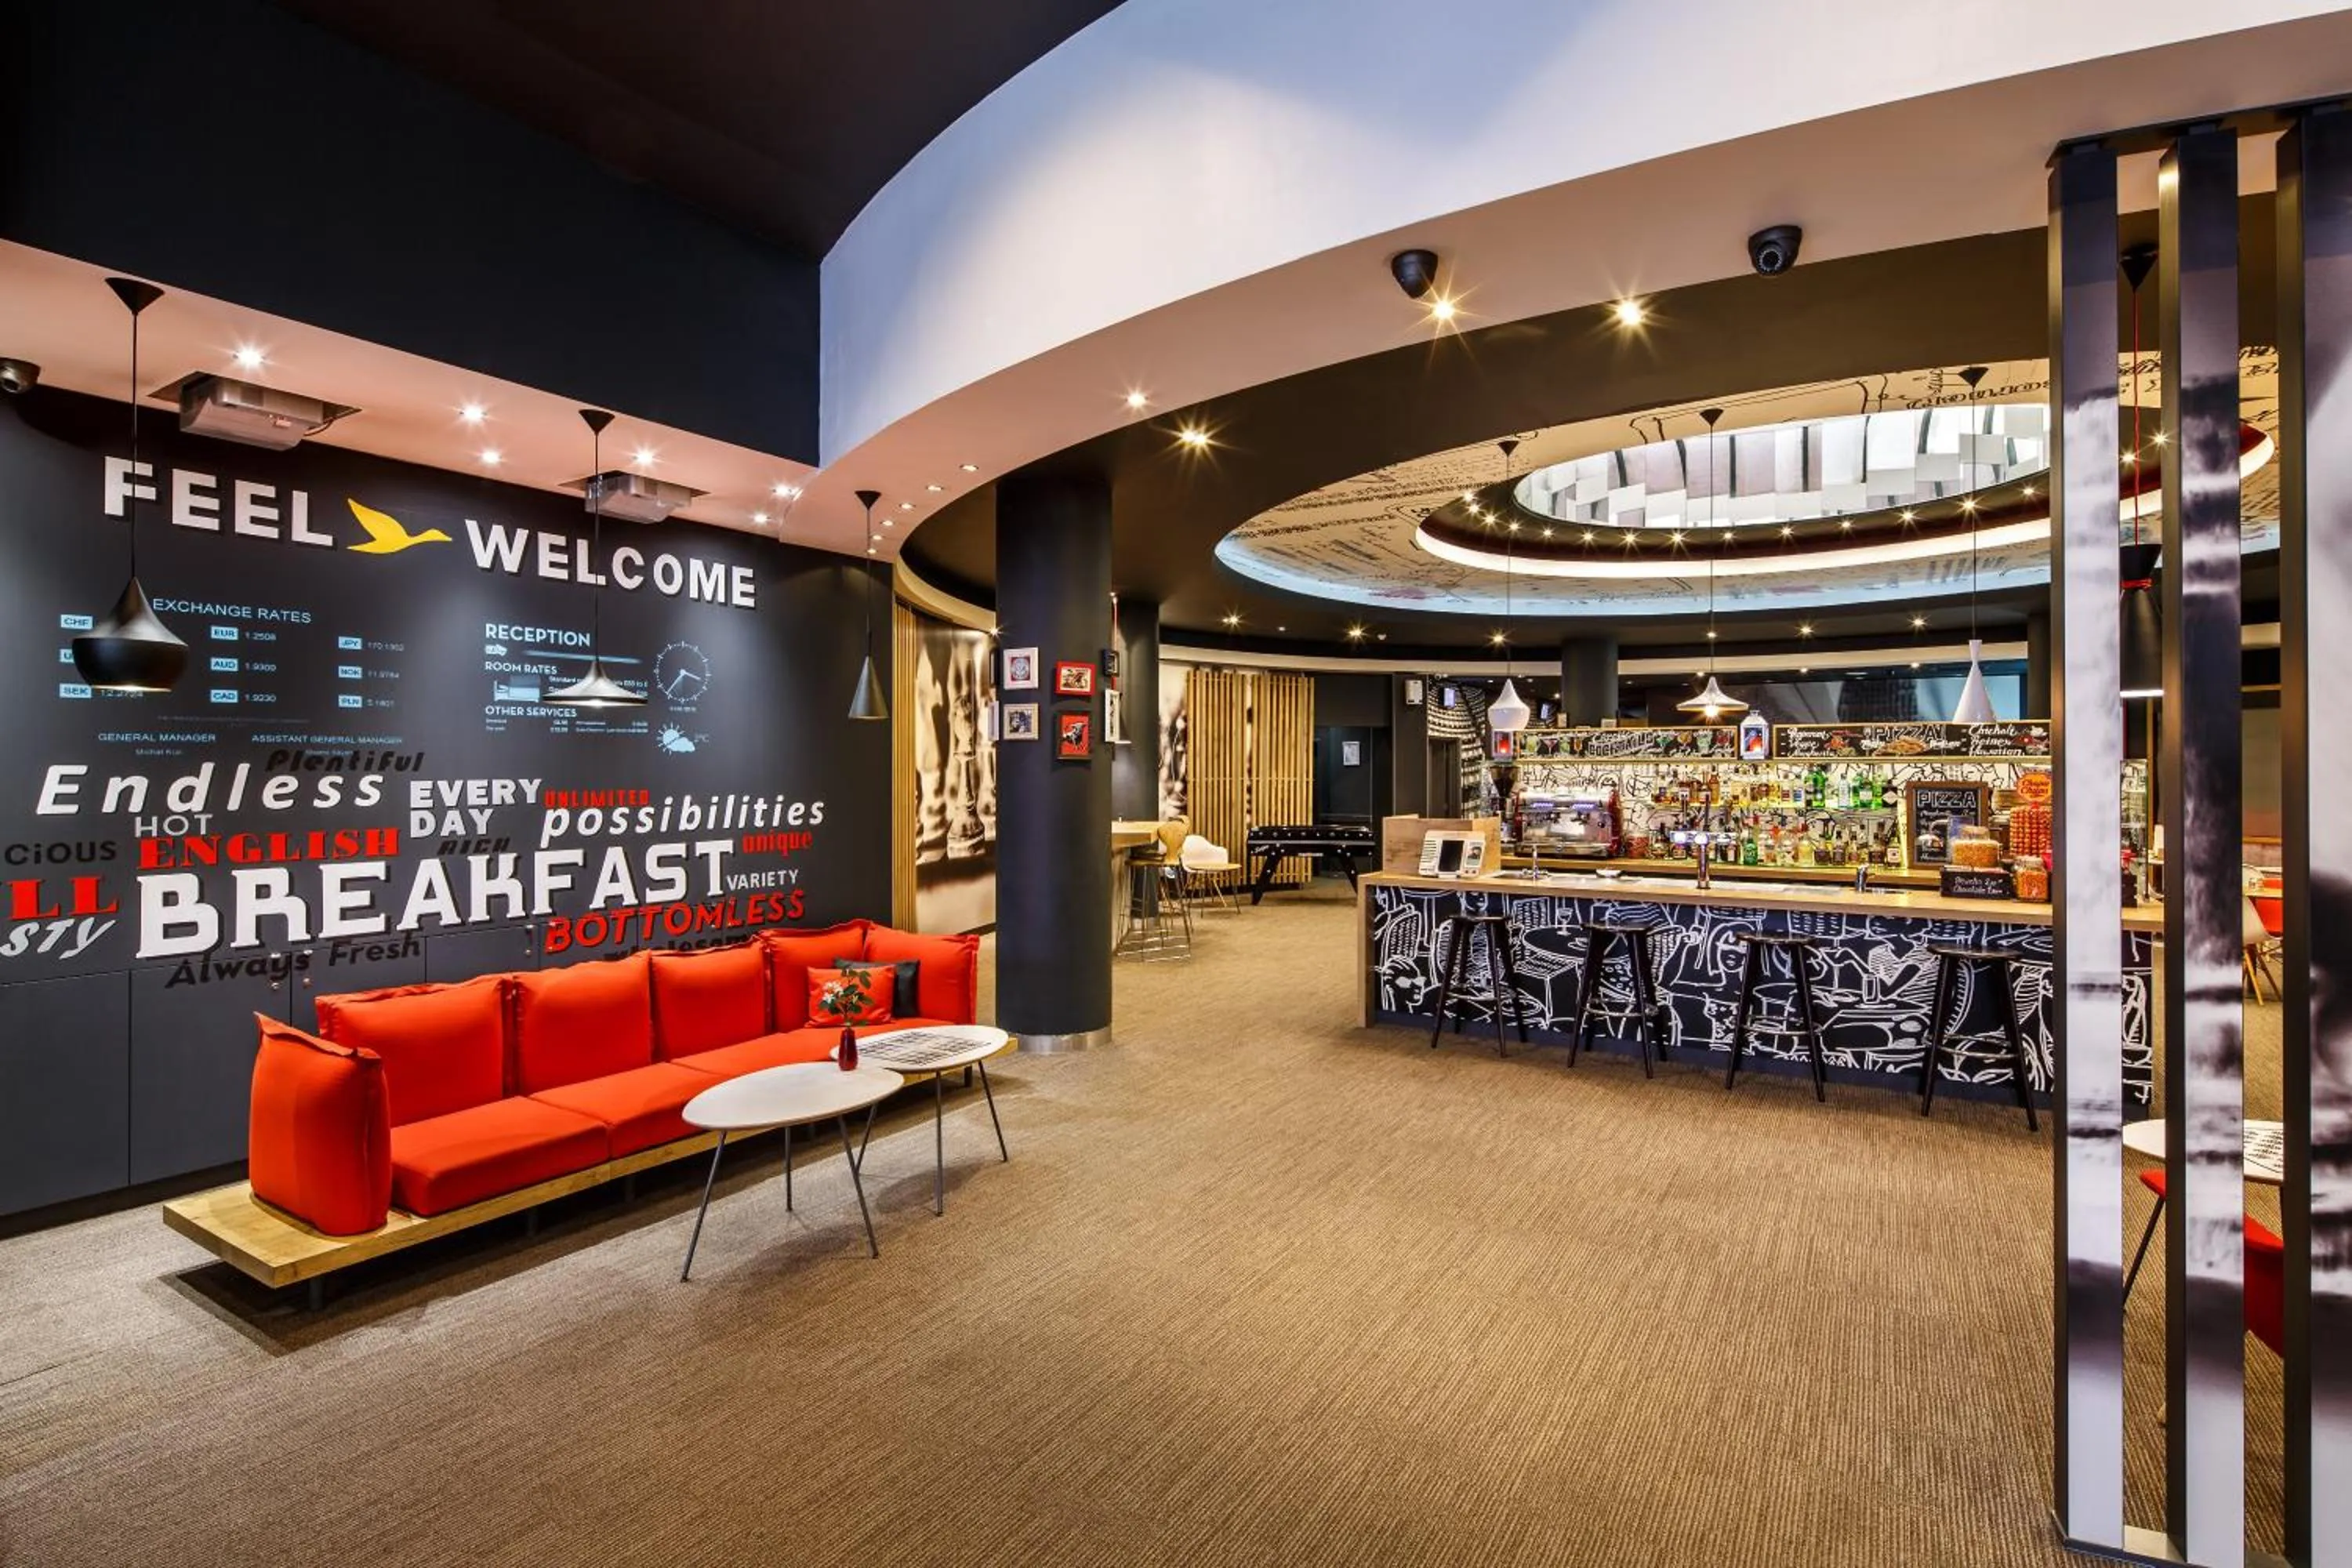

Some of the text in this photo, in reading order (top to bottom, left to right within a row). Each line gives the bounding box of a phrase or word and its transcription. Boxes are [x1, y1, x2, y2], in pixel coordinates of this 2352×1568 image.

[104, 456, 757, 609] FEEL WELCOME
[64, 617, 89, 626] CHF
[152, 598, 311, 623] EXCHANGE RATES
[213, 628, 235, 637] EUR
[485, 623, 591, 647] RECEPTION
[212, 660, 236, 669] AUD
[485, 661, 558, 674] ROOM RATES
[63, 687, 89, 695] SEK
[212, 692, 236, 701] CAD
[485, 706, 578, 718] OTHER SERVICES
[97, 732, 216, 742] GENERAL MANAGER
[251, 735, 403, 745] ASSISTANT GENERAL MANAGER
[265, 750, 425, 772] Plentiful
[36, 762, 384, 815] Endless
[409, 778, 543, 808] EVERY
[544, 789, 649, 808] UNLIMITED
[1918, 790, 1976, 808] PIZZA
[135, 813, 214, 838] HOT
[409, 808, 493, 839] DAY
[539, 793, 825, 849] possibilities
[136, 827, 401, 870] ENGLISH
[742, 829, 813, 856] unique
[726, 869, 799, 892] VARIETY
[6, 876, 118, 920] LL
[136, 839, 735, 960] BREAKFAST
[543, 889, 805, 954] BOTTOMLESS
[165, 930, 421, 989] Always Fresh
